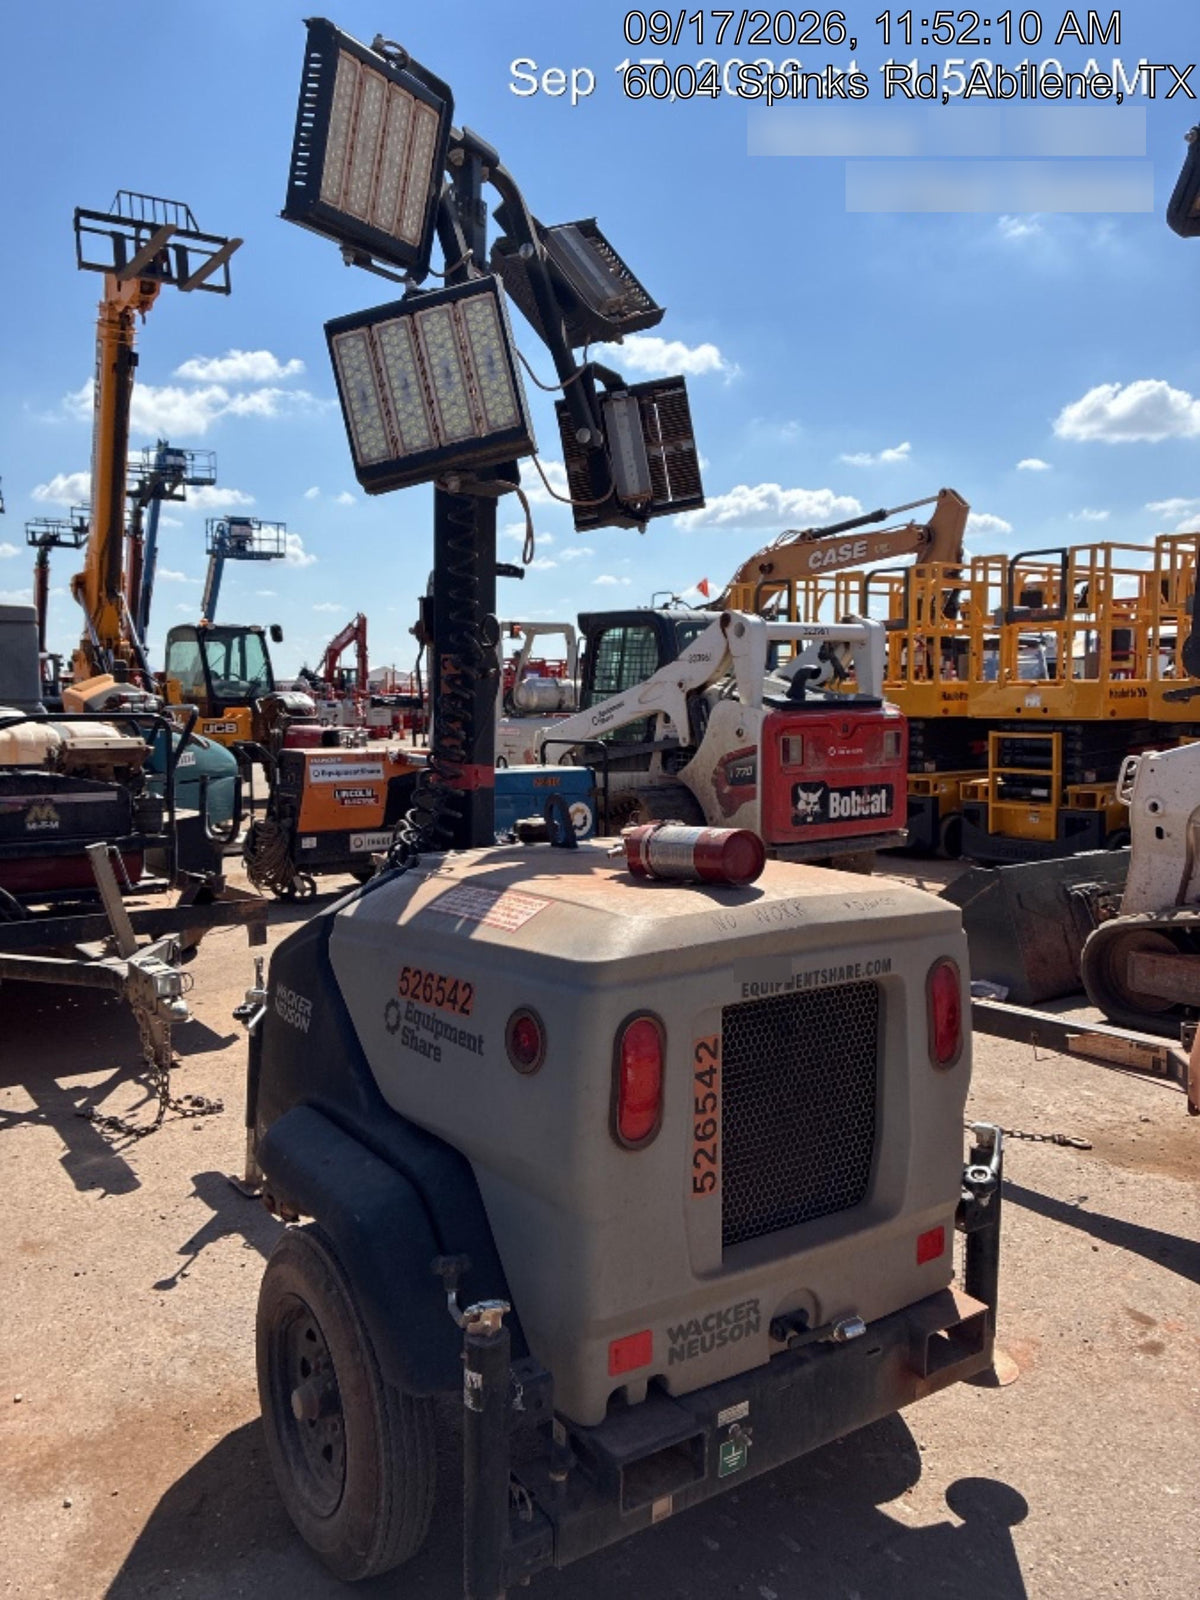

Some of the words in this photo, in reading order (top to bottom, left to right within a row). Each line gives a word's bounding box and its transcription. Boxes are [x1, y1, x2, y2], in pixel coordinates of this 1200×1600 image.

[808, 540, 868, 569] CASE
[203, 723, 237, 734] JCB
[828, 788, 888, 819] Bobcat
[276, 984, 314, 1018] WACKER
[399, 966, 474, 1016] 526542
[401, 1025, 442, 1063] Share
[404, 1001, 485, 1056] Equipment
[692, 1037, 719, 1194] 526542
[666, 1297, 761, 1345] WACKER
[667, 1316, 762, 1366] NEUSON
